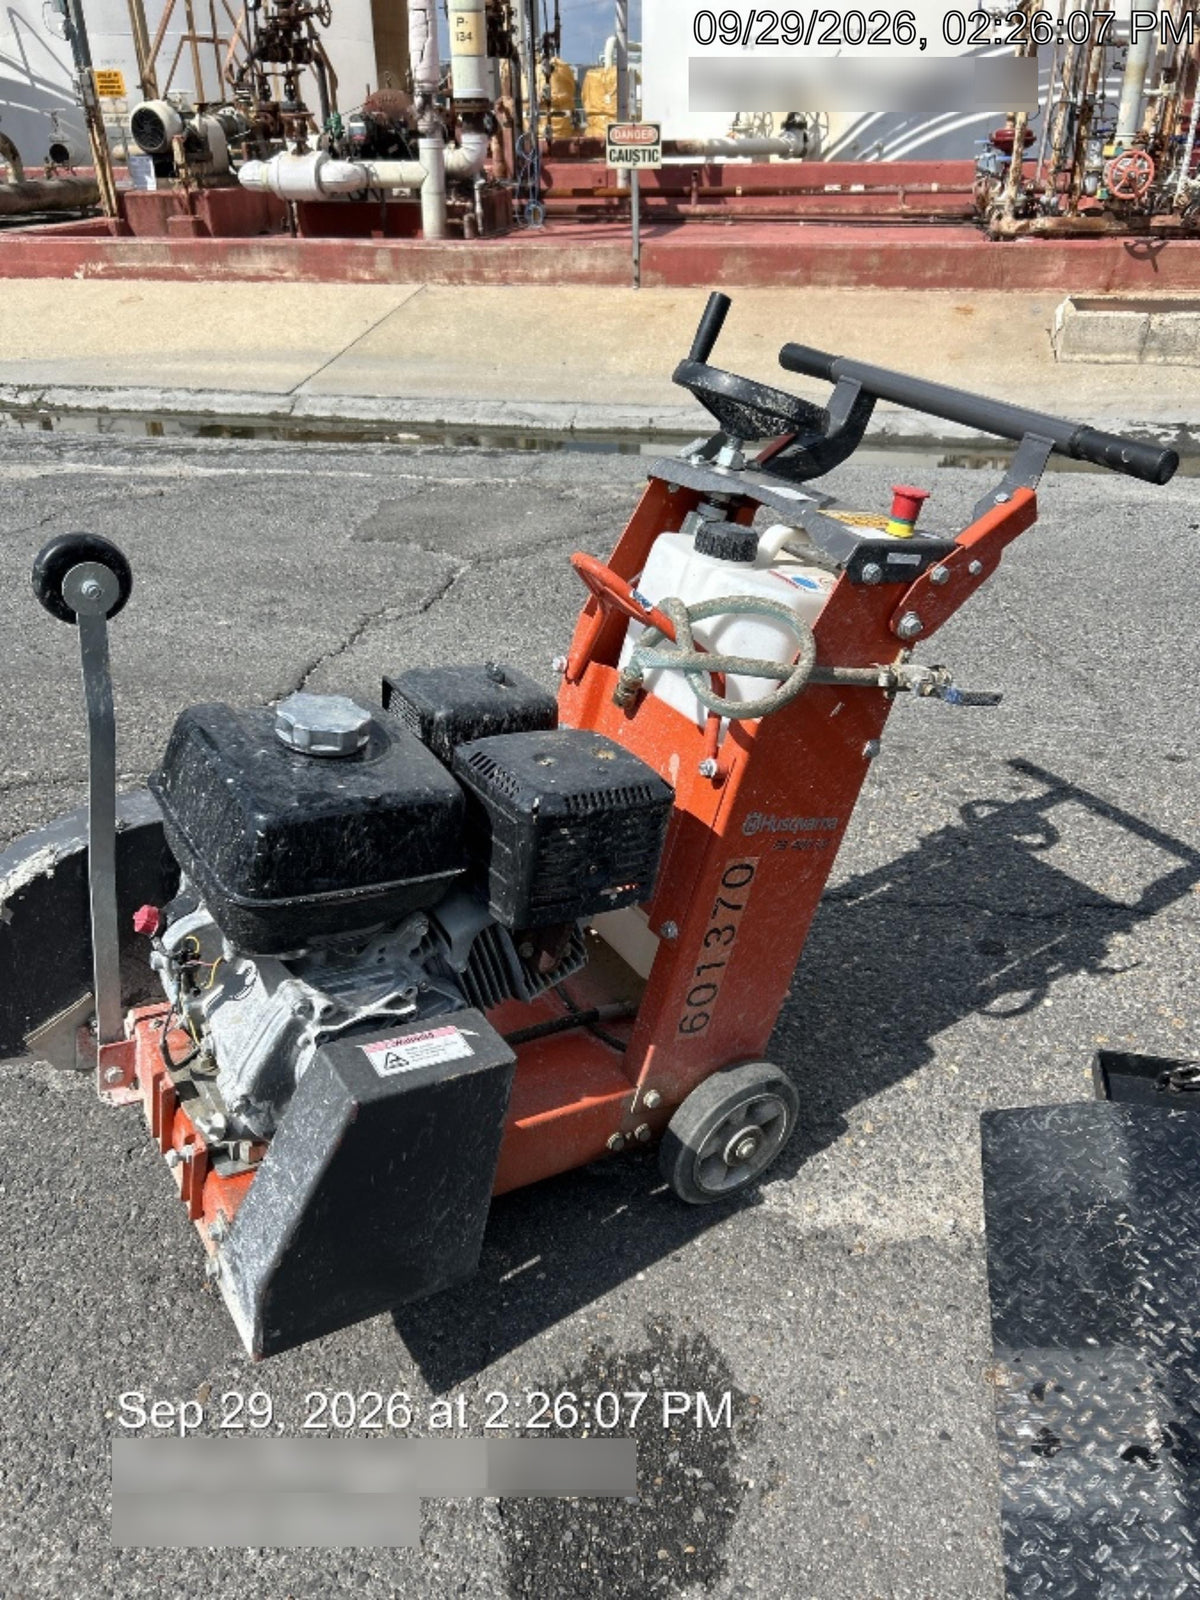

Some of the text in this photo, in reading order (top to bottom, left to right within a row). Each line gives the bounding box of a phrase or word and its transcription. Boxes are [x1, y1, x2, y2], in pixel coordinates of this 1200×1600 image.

[613, 128, 656, 140] DANGER
[609, 148, 660, 163] CAUSTIC
[760, 814, 838, 835] Husqvarna
[679, 863, 755, 1034] 601370
